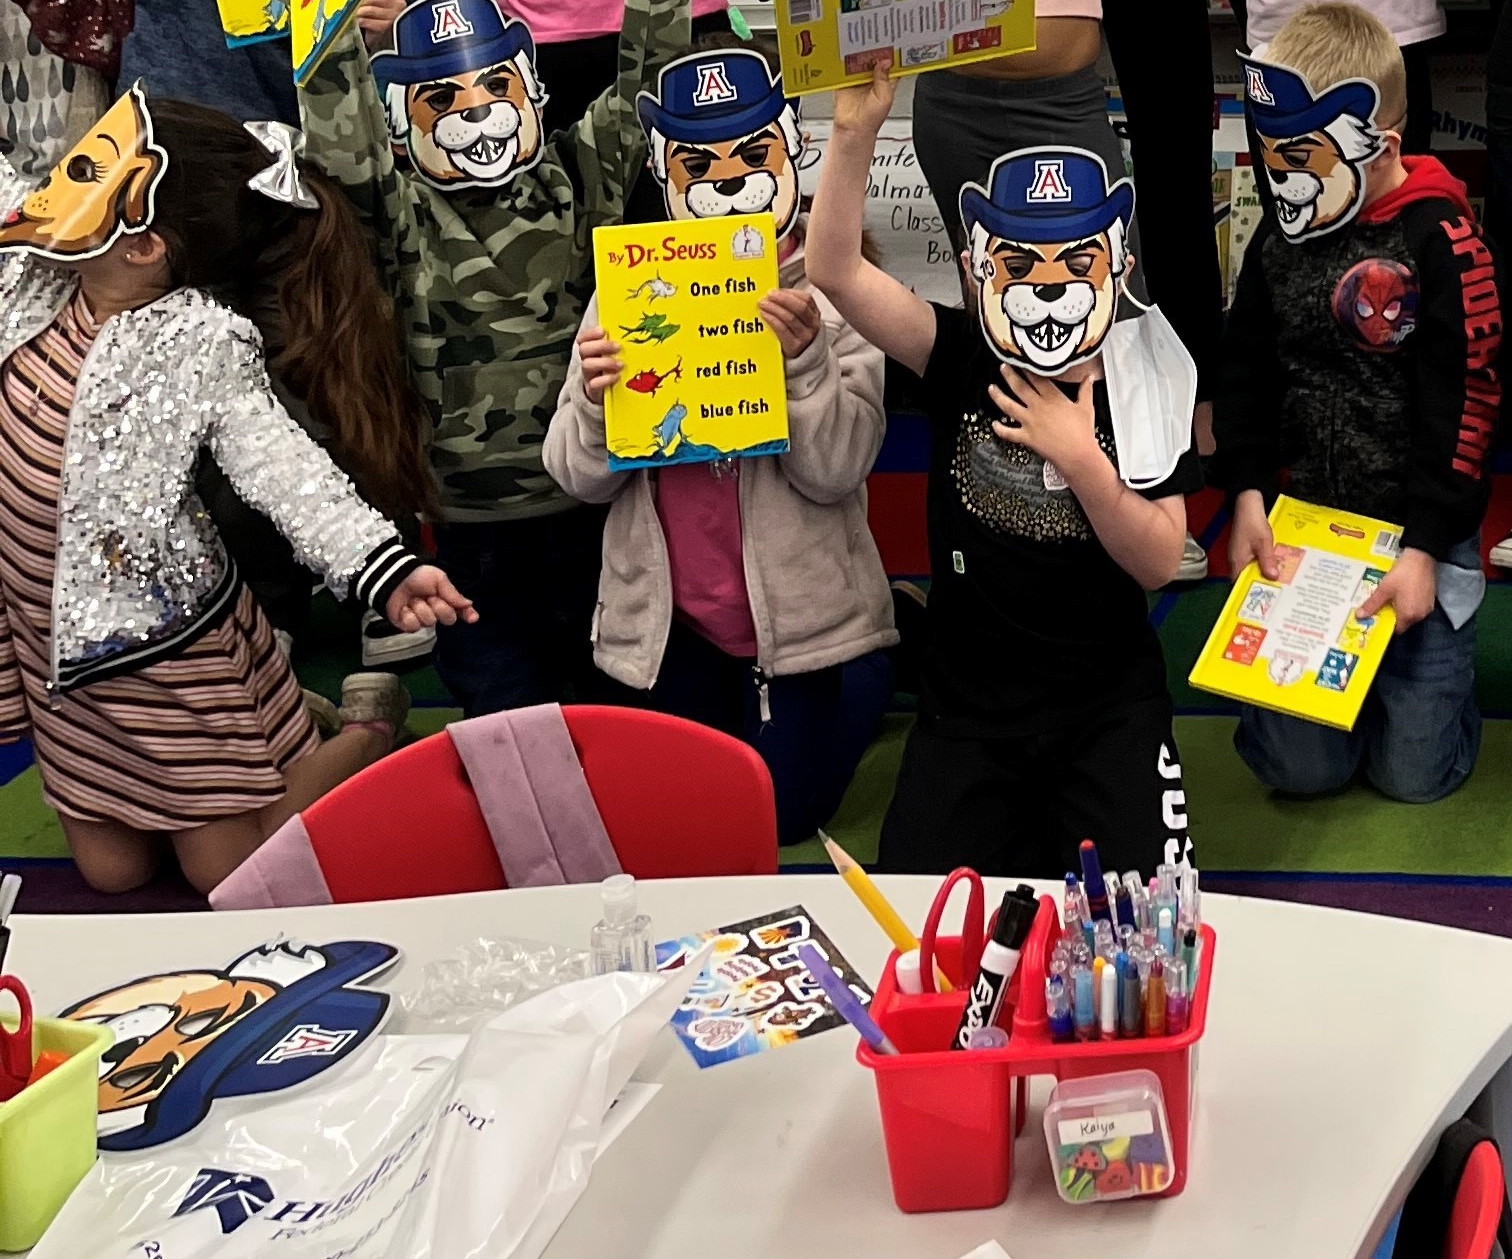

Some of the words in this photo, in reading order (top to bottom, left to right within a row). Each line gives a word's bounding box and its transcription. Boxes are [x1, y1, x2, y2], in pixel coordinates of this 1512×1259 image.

[693, 61, 738, 106] A
[1027, 159, 1071, 203] A
[891, 205, 945, 233] Class
[607, 252, 625, 266] By
[624, 244, 659, 269] Dr.
[662, 236, 717, 261] Seuss
[690, 282, 720, 297] One
[725, 277, 756, 294] fish
[698, 324, 729, 338] two
[733, 317, 764, 335] fish
[696, 362, 721, 378] red
[726, 359, 757, 376] fish
[700, 404, 734, 419] blue
[737, 398, 769, 415] fish
